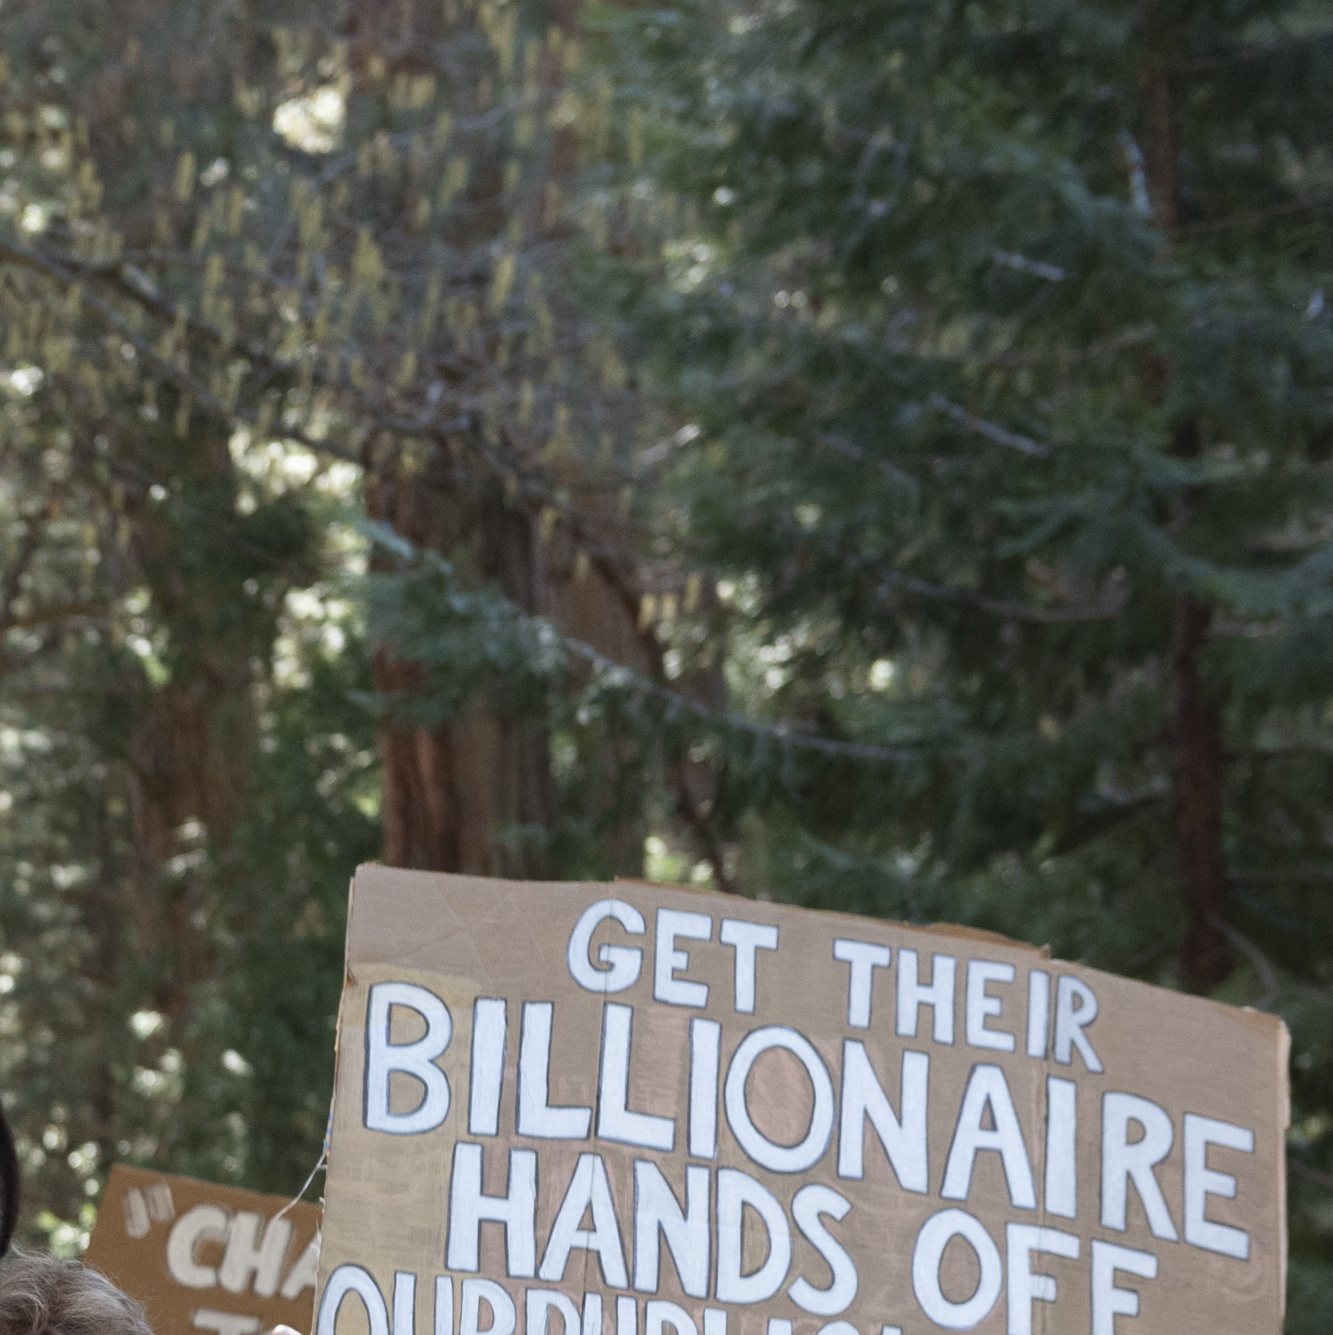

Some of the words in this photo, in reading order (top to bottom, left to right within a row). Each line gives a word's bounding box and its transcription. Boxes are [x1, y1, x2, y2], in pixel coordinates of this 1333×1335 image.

[566, 897, 780, 1014] GET
[832, 936, 1105, 1075] THEIR
[362, 980, 1257, 1260] BILLIONAIRE
[445, 1140, 859, 1317] HANDS
